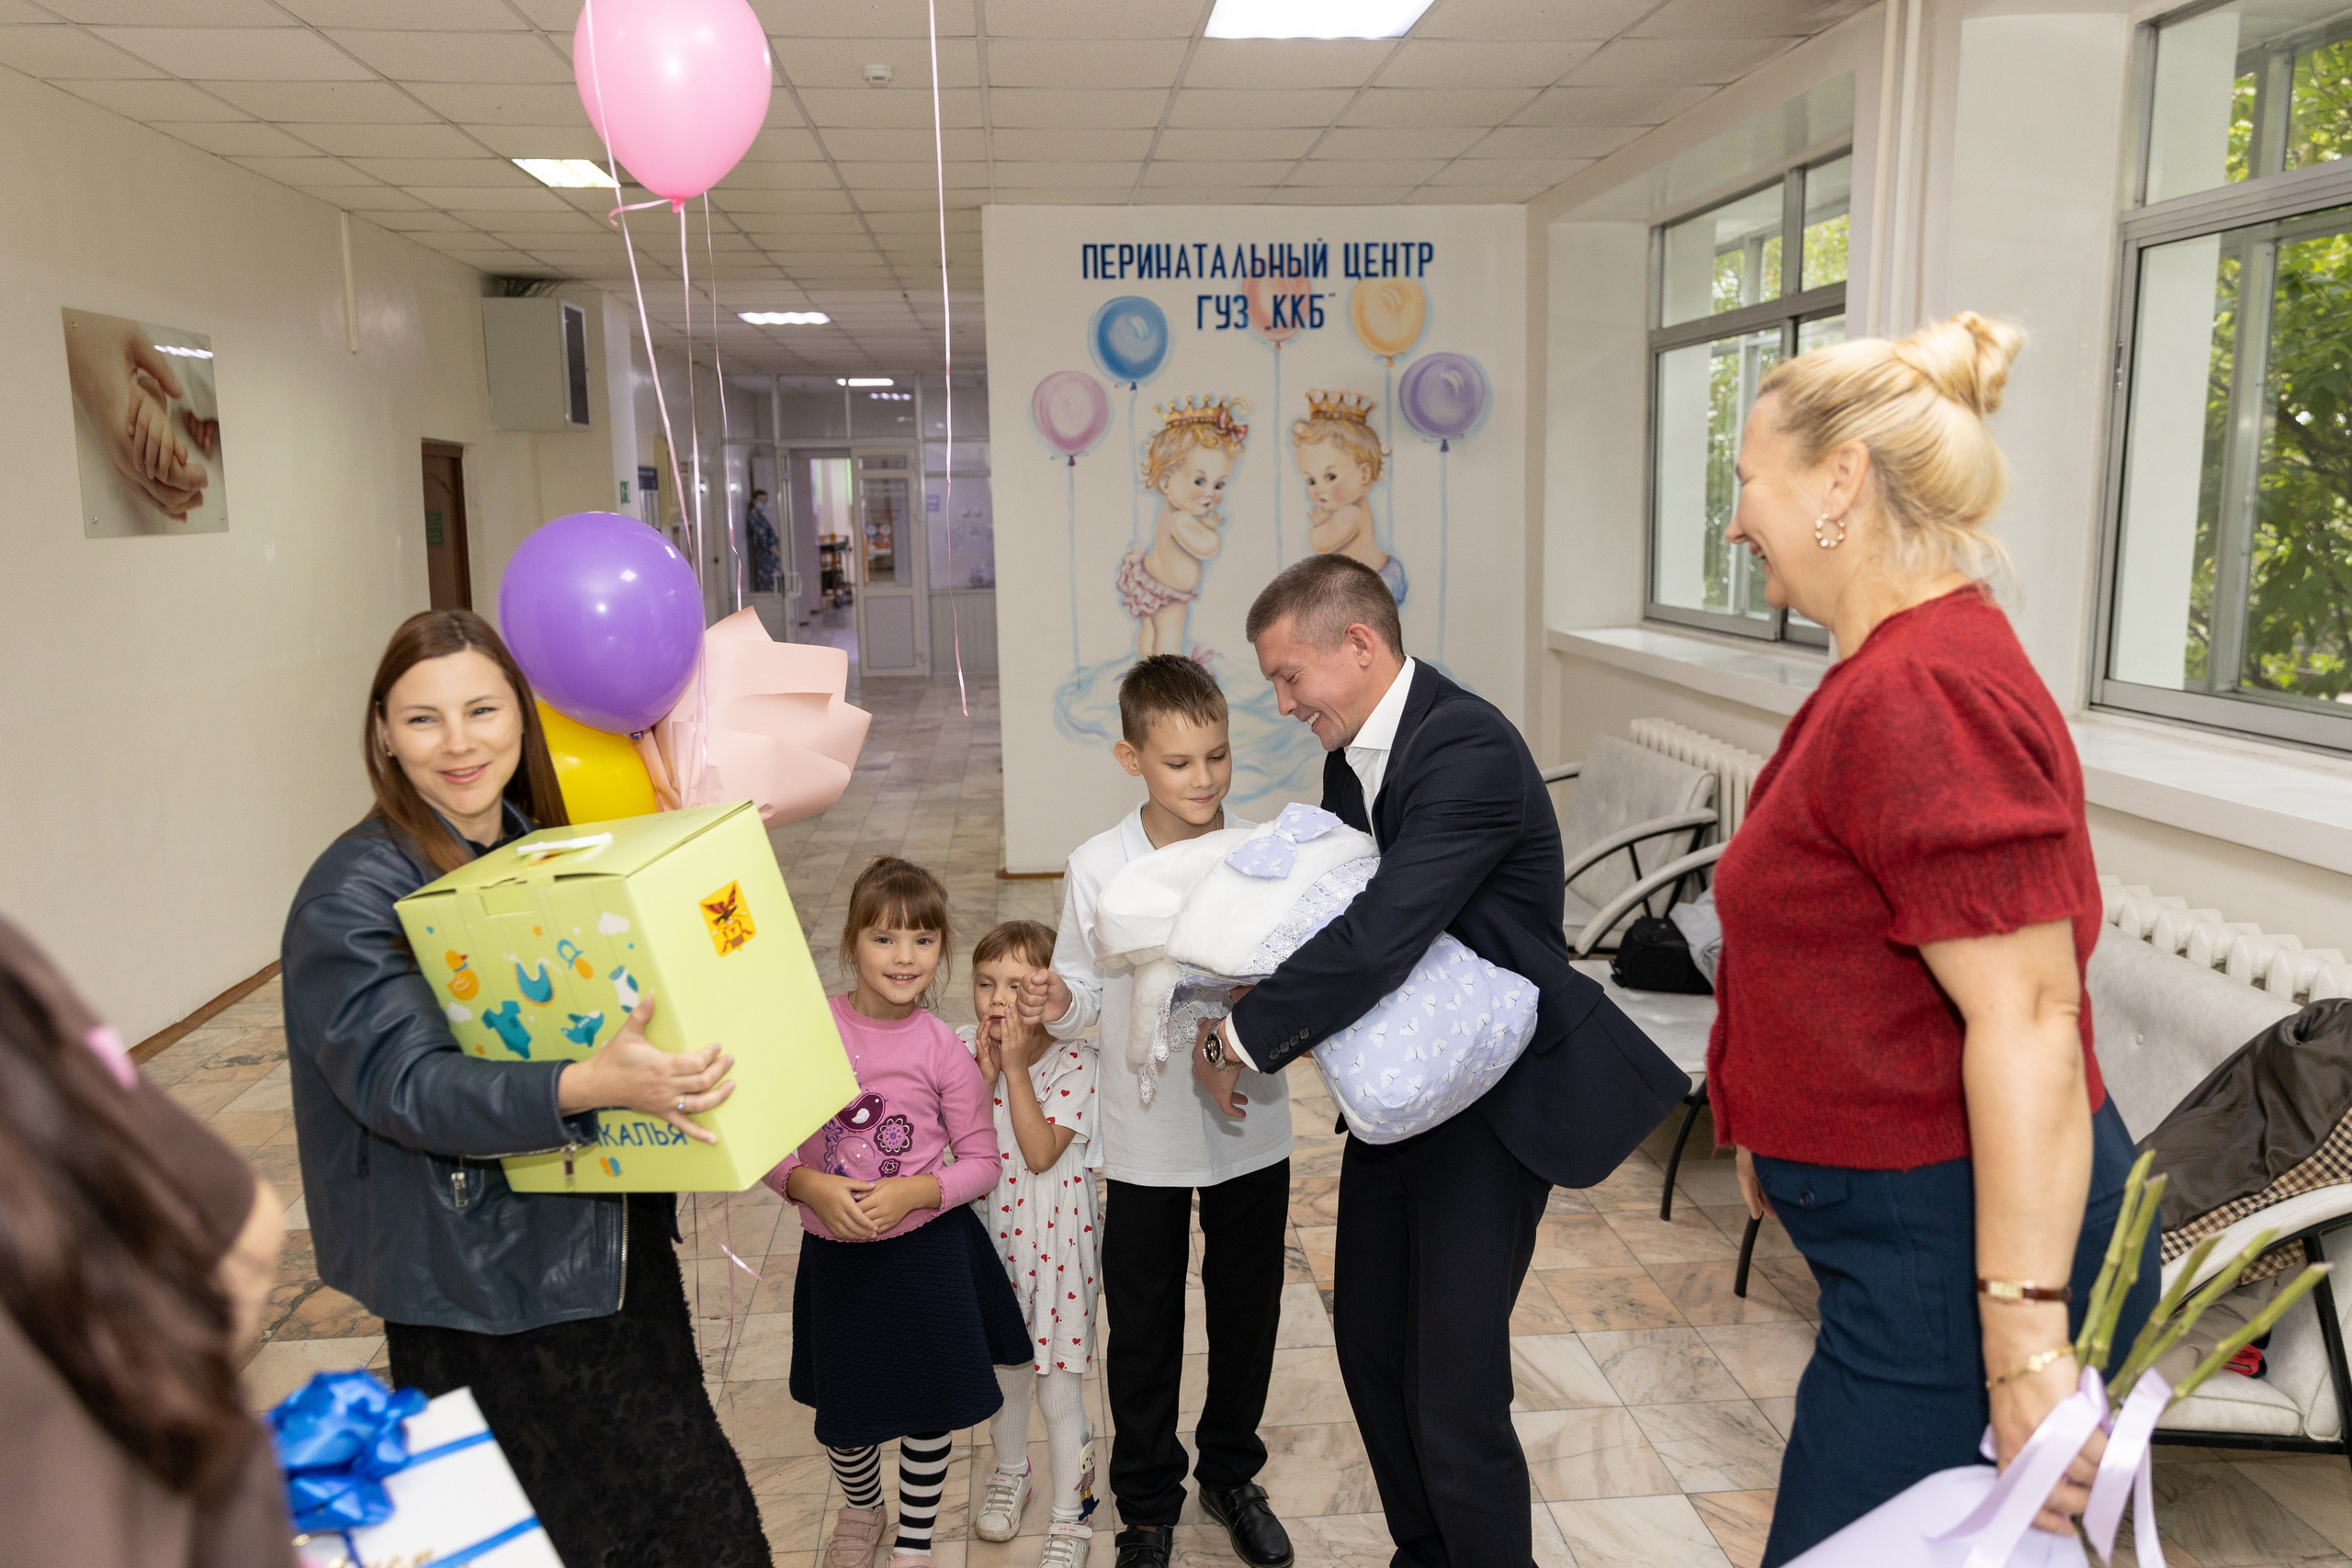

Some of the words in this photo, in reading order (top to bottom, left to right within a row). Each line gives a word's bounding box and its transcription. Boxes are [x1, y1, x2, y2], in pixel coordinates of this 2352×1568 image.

[1082, 237, 1329, 279] ПЕРИНАТАЛЬНЫЙ
[1343, 242, 1434, 281] ЦЕНТР
[1197, 294, 1250, 331] ГУЗ
[597, 1122, 688, 1146] КАЛЬЯ
